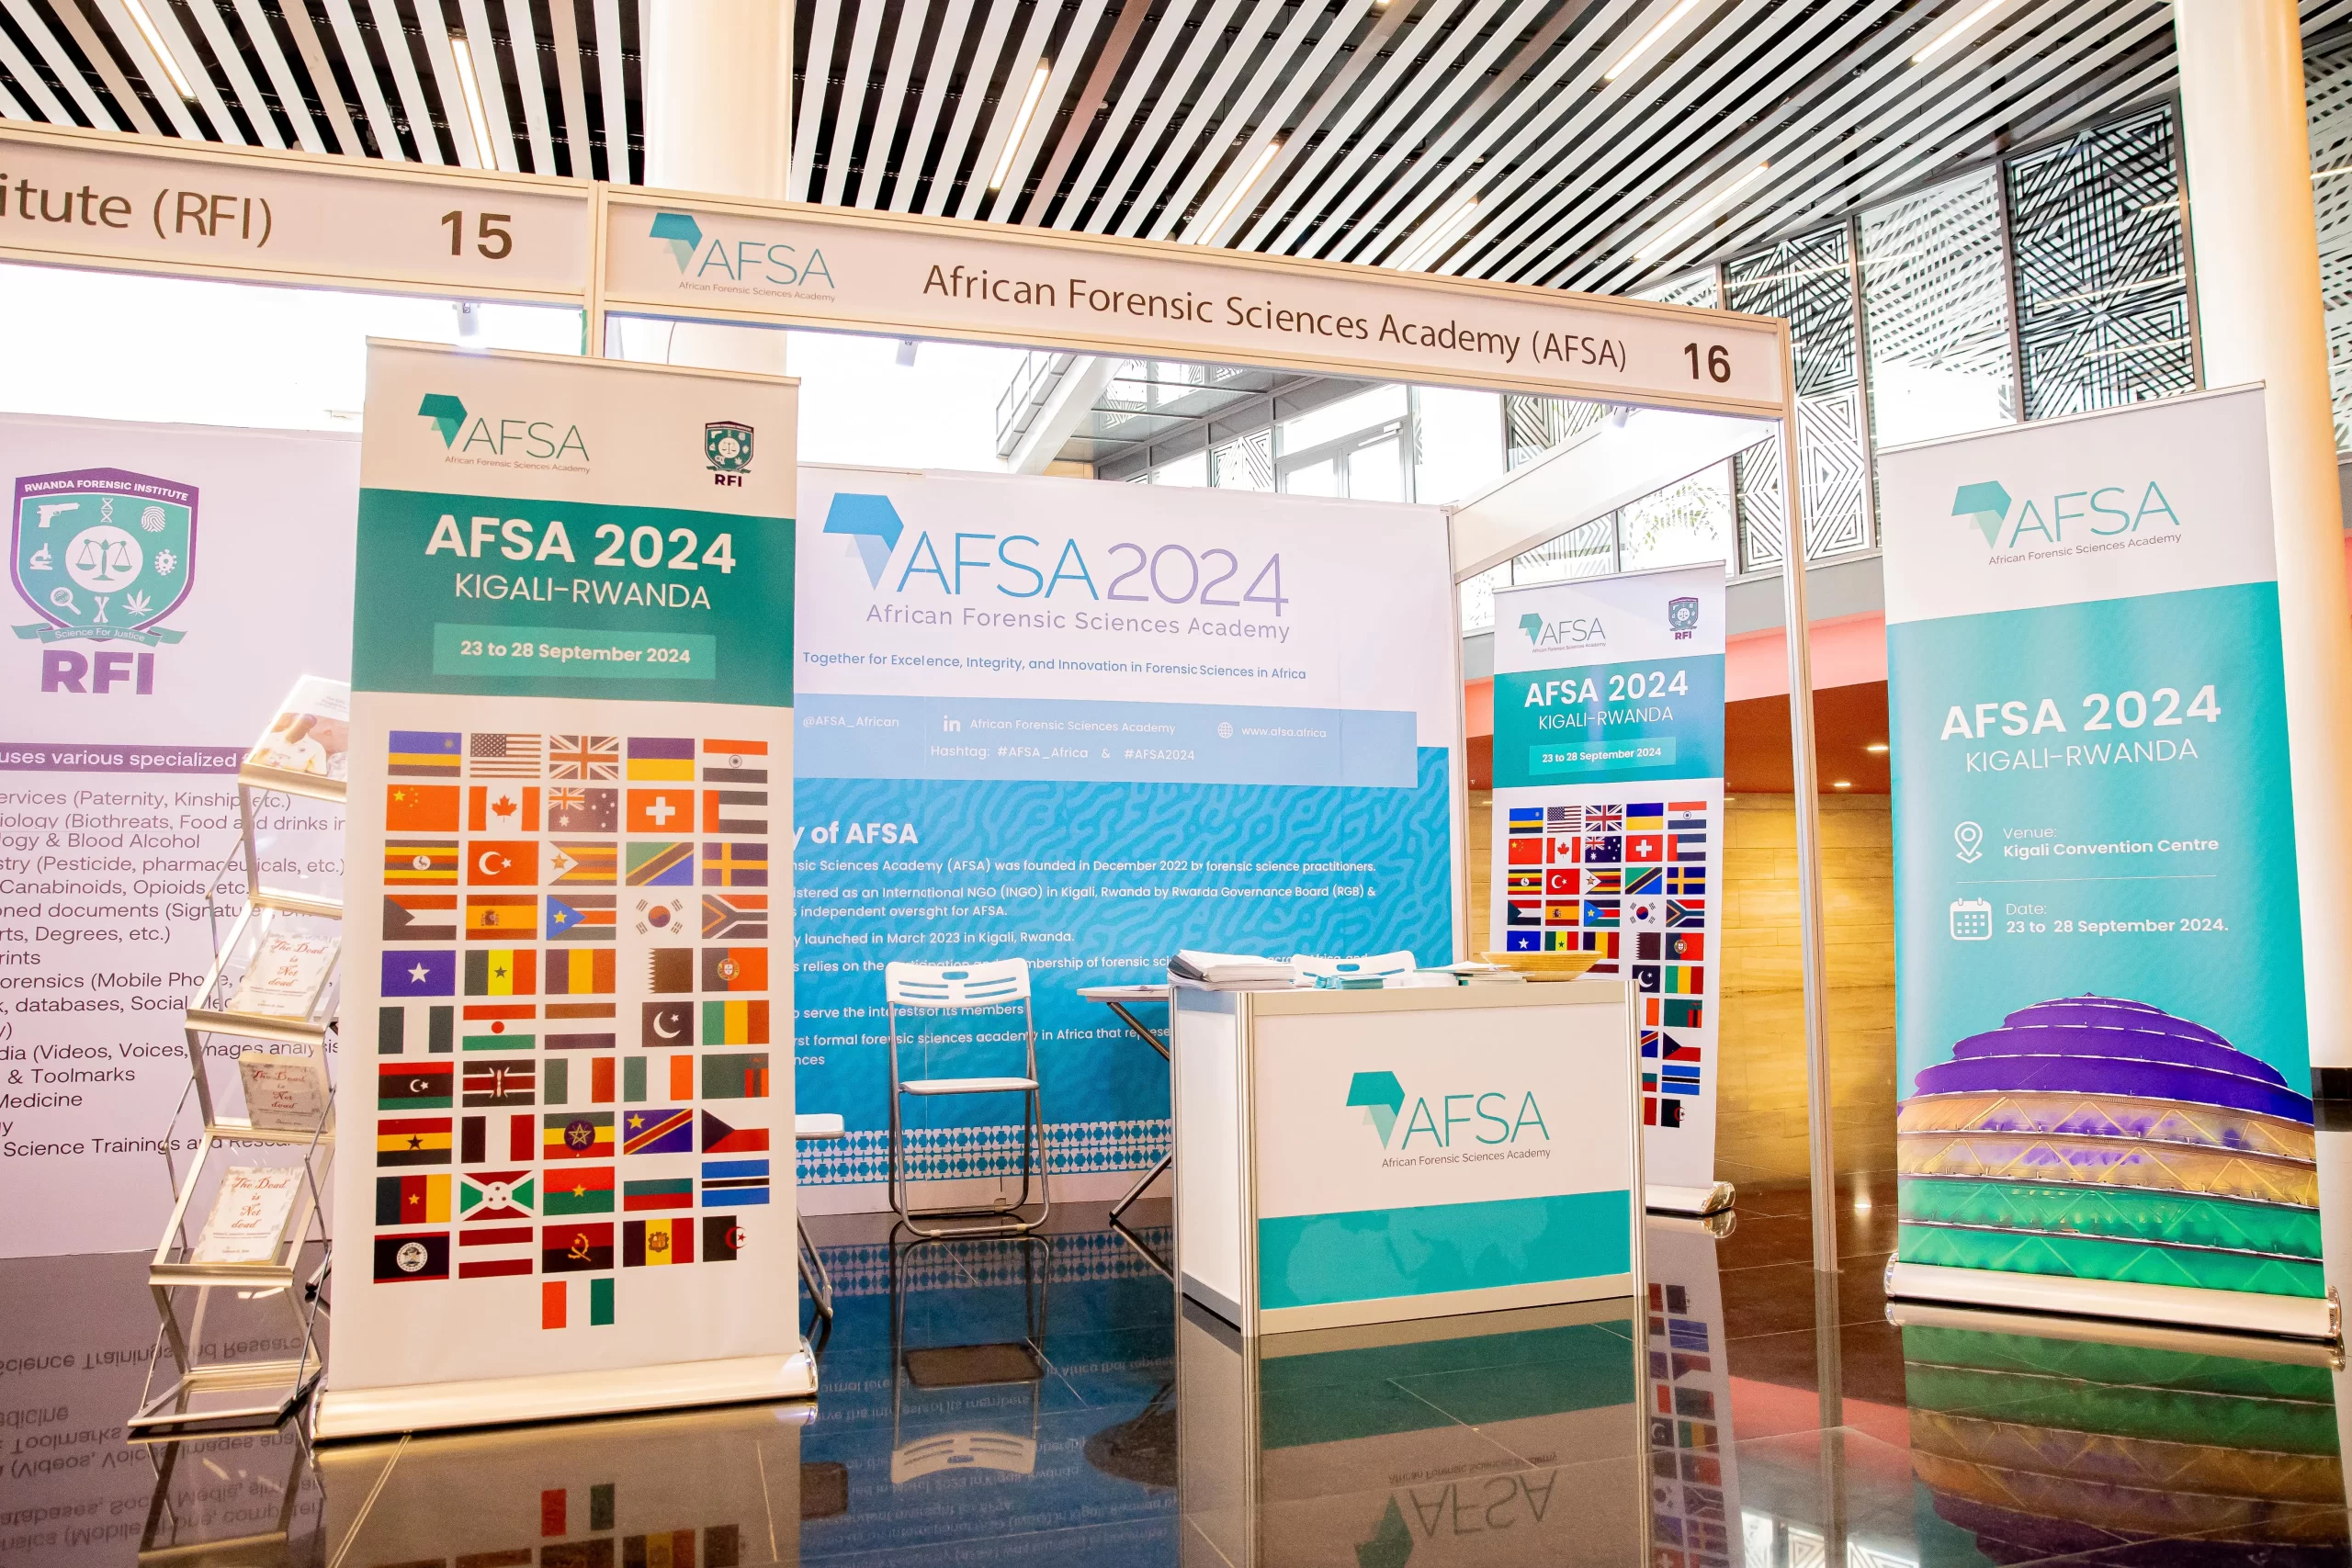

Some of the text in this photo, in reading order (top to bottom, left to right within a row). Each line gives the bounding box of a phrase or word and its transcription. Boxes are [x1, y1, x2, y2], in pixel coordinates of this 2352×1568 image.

[0, 173, 271, 248] itute (RFI)
[441, 210, 512, 259] 15
[697, 239, 834, 288] AFSA
[678, 281, 835, 302] African Forensic Sciences Academy
[922, 265, 1625, 372] African Forensic Sciences Academy (AFSA)
[1684, 342, 1730, 383] 16
[463, 417, 589, 461] AFSA
[444, 456, 590, 474] African Forensic Sciences Academy
[715, 474, 741, 487] RFI
[25, 479, 188, 502] RWANDA FORENSIC INSTITUTE
[2008, 481, 2180, 547] AFSA
[424, 514, 736, 573] AFSA 2024
[1988, 534, 2181, 565] African Forensic Sciences Academy
[897, 531, 1100, 601] AFSA
[1107, 542, 1288, 616] 2024
[456, 572, 710, 609] KIGALI-RWANDA
[865, 604, 1289, 643] African Forensic Sciences Academy
[1541, 617, 1606, 645] AFSA
[54, 627, 145, 641] Science For Justice
[1675, 631, 1691, 640] RFI
[460, 640, 690, 662] 23 to 28 September 2024
[41, 649, 154, 694] RFI
[802, 651, 1306, 679] Together for Integrity, and Innovation in Forensic Sciences in Africa
[1524, 671, 1688, 707] AFSA 2024
[802, 716, 899, 728] @AFSA_African
[1539, 706, 1673, 729] KIGALI-RWANDA
[1940, 685, 2221, 740] AFSA 2024
[969, 718, 1175, 735] African Forensic Sciences Academy
[1241, 727, 1326, 738] www.afsa.africa
[51, 750, 236, 769] various specialized
[931, 745, 1194, 760] Hashtag: #AFSA_Africa & #AFSA2024
[1543, 748, 1661, 762] 23 to 28 September 2024
[1966, 738, 2198, 772] KIGALI-RWANDA
[74, 790, 167, 809] (Paternity,
[64, 813, 227, 830] (Biothreats, Food
[274, 816, 327, 829] drinks
[45, 832, 199, 848] & Blood Alcohol
[810, 820, 918, 843] of AFSA
[2002, 827, 2056, 839] Venue:
[2004, 839, 2219, 860] Kigali Convention Centre
[37, 855, 136, 874] (Pesticide,
[820, 858, 1375, 874] Sciences Academy (AFSA) founded December 2022 forensic science practitioners.
[0, 879, 126, 896] Canabinoids,
[967, 885, 1363, 900] NGO (INGO) Kigali, Rwanda Governance Board (RGB)
[48, 902, 158, 917] documents
[800, 905, 1007, 919] independent AFSA.
[2006, 903, 2046, 915] Date:
[35, 926, 170, 944] Degrees, etc.)
[2007, 918, 2228, 936] 23 to 28 September 2024.
[805, 931, 1074, 946] launched 2023 Kigali, Rwanda.
[91, 972, 162, 991] (Mobile
[15, 995, 187, 1014] databases, Social
[33, 1041, 189, 1064] (Videos, Voices,
[7, 1066, 135, 1084] & Toolmarks
[1402, 1091, 1550, 1150] AFSA
[3, 1140, 85, 1156] Science
[1381, 1148, 1550, 1168] African Forensic Sciences Academy
[240, 1203, 261, 1216] Not
